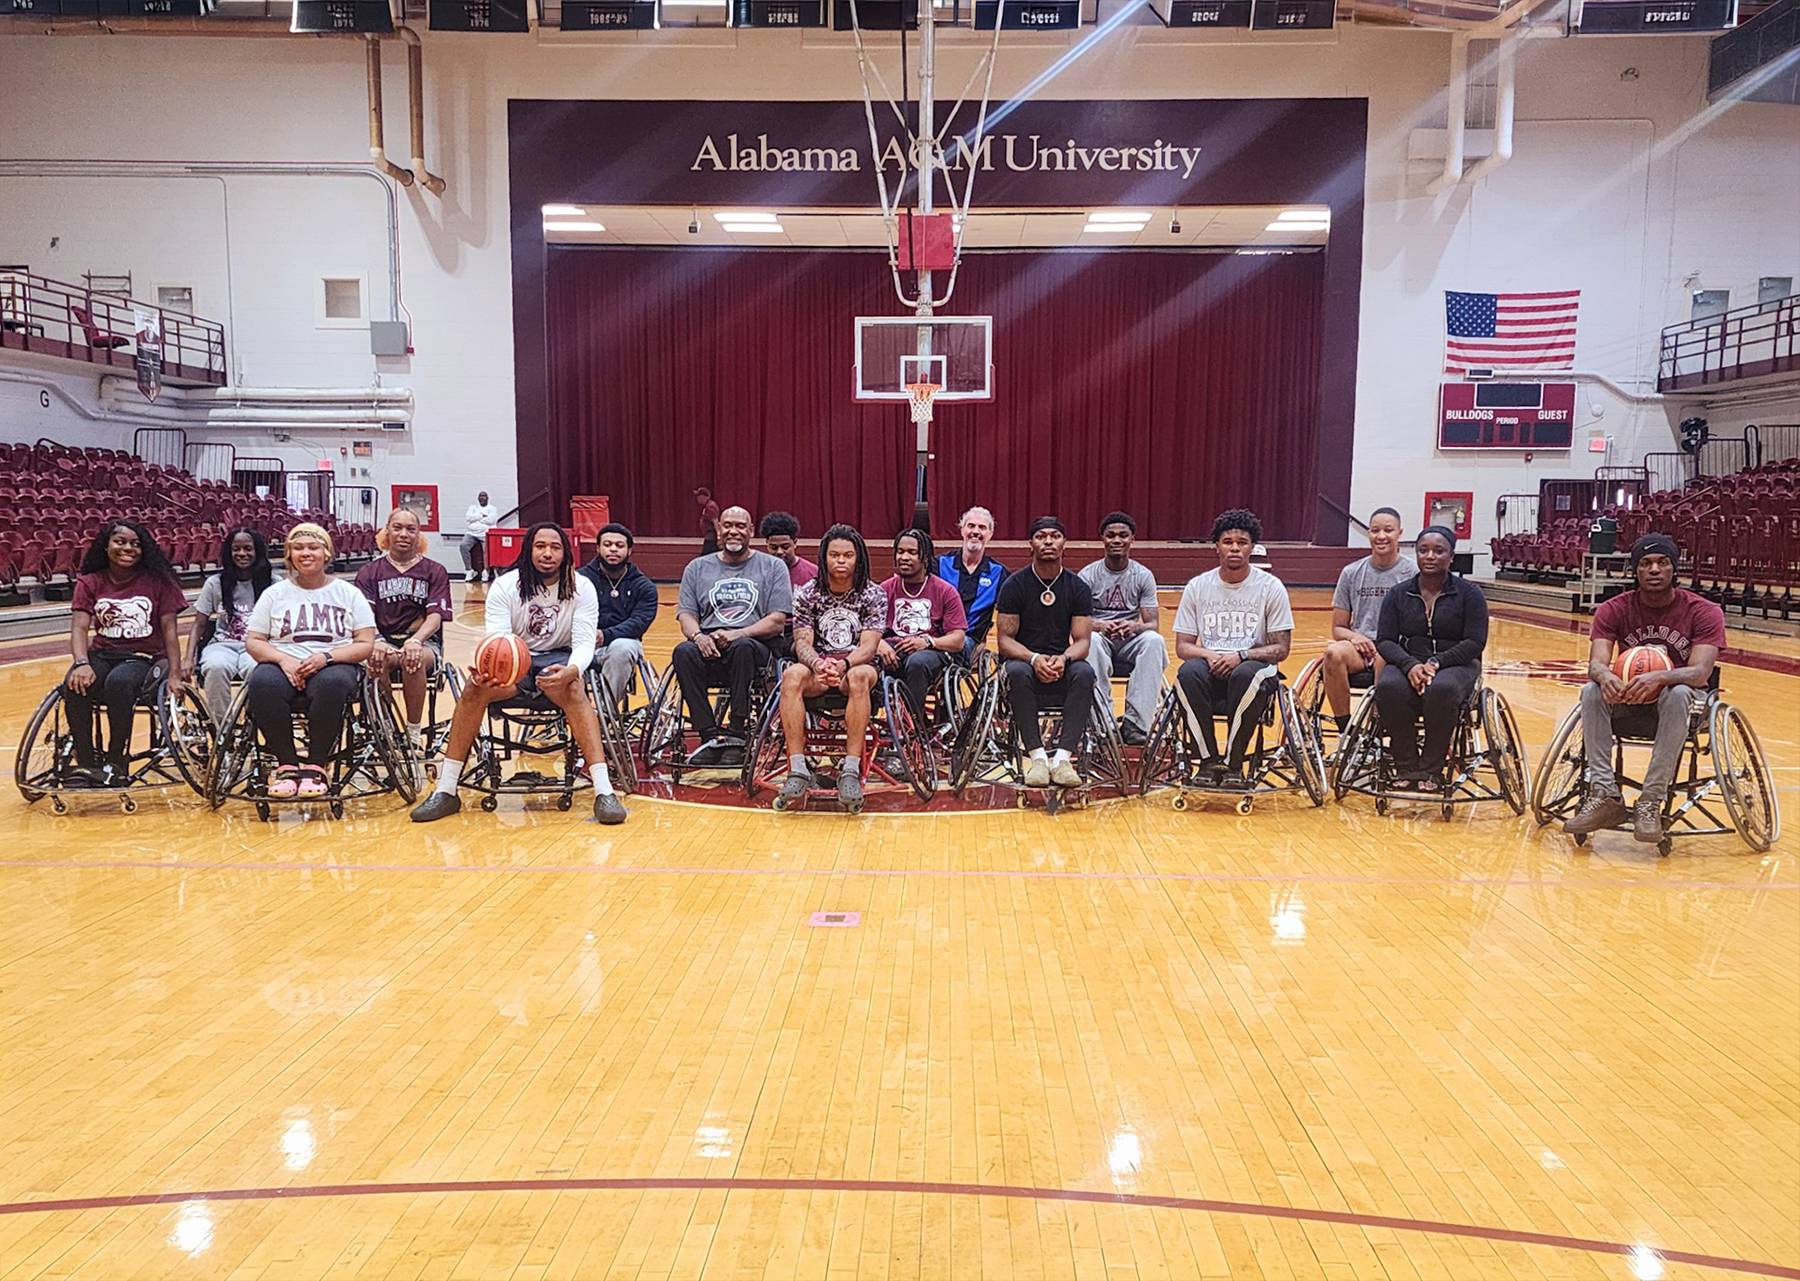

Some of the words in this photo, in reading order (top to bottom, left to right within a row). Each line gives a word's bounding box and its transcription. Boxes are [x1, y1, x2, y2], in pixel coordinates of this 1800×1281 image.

[690, 133, 862, 172] Alabama
[1002, 134, 1202, 179] University
[40, 390, 50, 407] G
[1446, 409, 1494, 420] BULLDOGS
[1538, 410, 1568, 420] GUEST
[1496, 417, 1519, 425] PERIOD
[279, 602, 347, 639] AAMU
[1203, 610, 1259, 639] PCHS
[1624, 625, 1690, 661] ULLDOG
